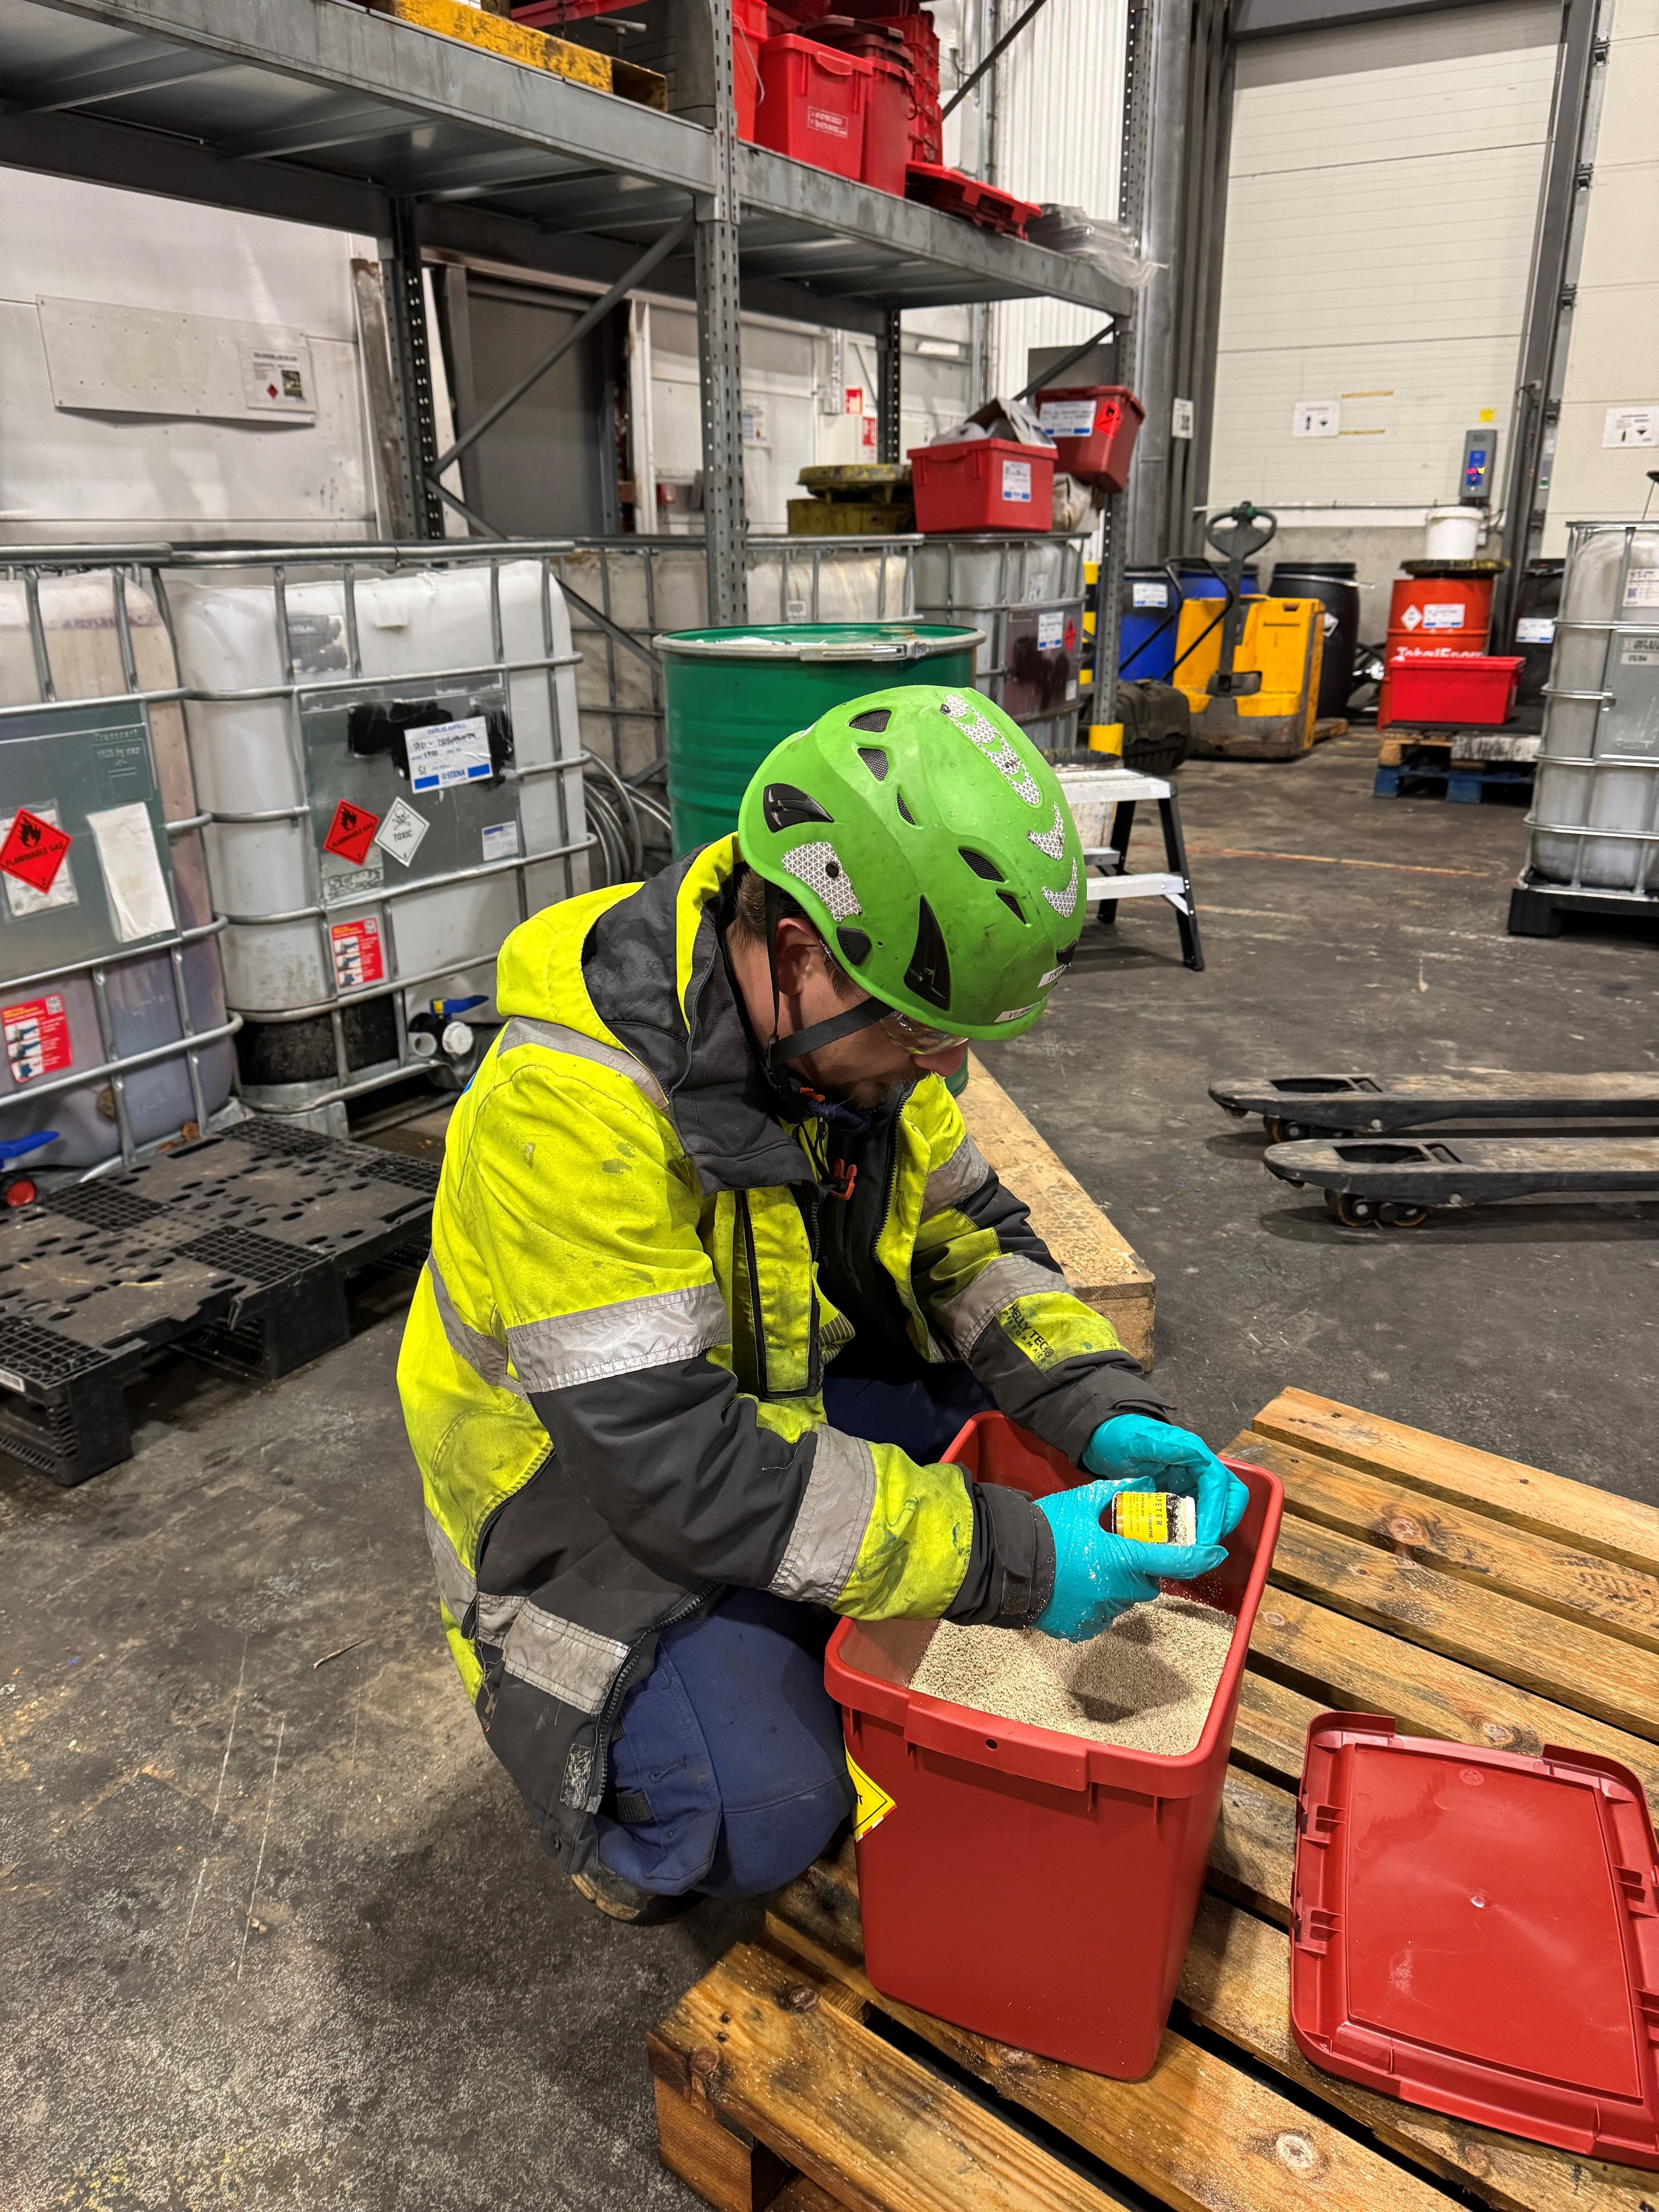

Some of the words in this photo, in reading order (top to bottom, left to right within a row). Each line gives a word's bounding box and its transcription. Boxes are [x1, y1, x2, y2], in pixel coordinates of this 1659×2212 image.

[447, 769, 465, 779] STENA
[393, 830, 412, 842] TOXIC
[5, 847, 48, 866] FLAMMABLE
[49, 842, 64, 852] GAS
[1008, 1303, 1032, 1331] HELLY
